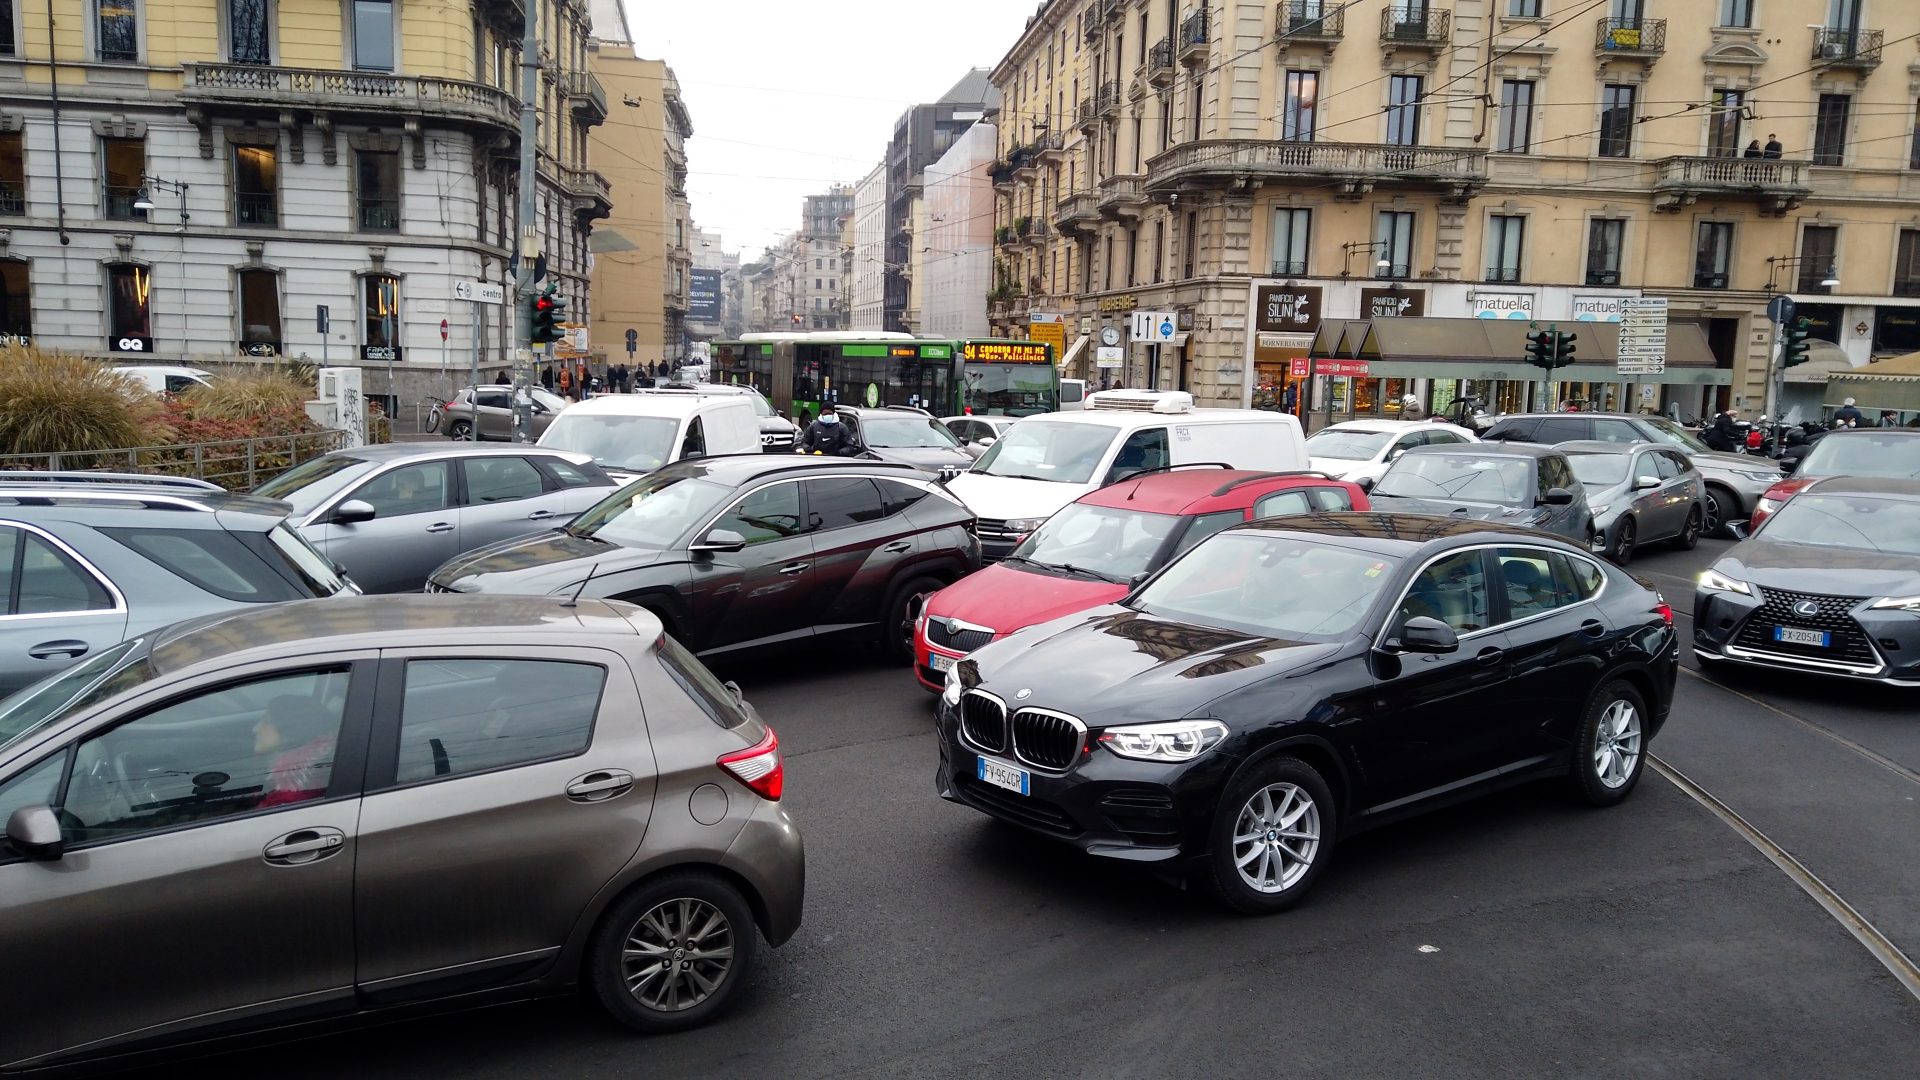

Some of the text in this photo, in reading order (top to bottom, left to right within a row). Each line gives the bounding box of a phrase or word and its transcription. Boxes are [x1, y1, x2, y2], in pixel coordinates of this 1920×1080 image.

[482, 290, 502, 298] centro
[1269, 294, 1294, 303] PANIFICIO
[1372, 296, 1397, 306] PANIFICIO
[1475, 296, 1532, 310] matuella
[1575, 298, 1621, 313] matuell
[1268, 303, 1294, 318] SILINI
[1372, 306, 1397, 316] SILINI
[119, 338, 143, 350] GQ
[965, 345, 975, 360] 94
